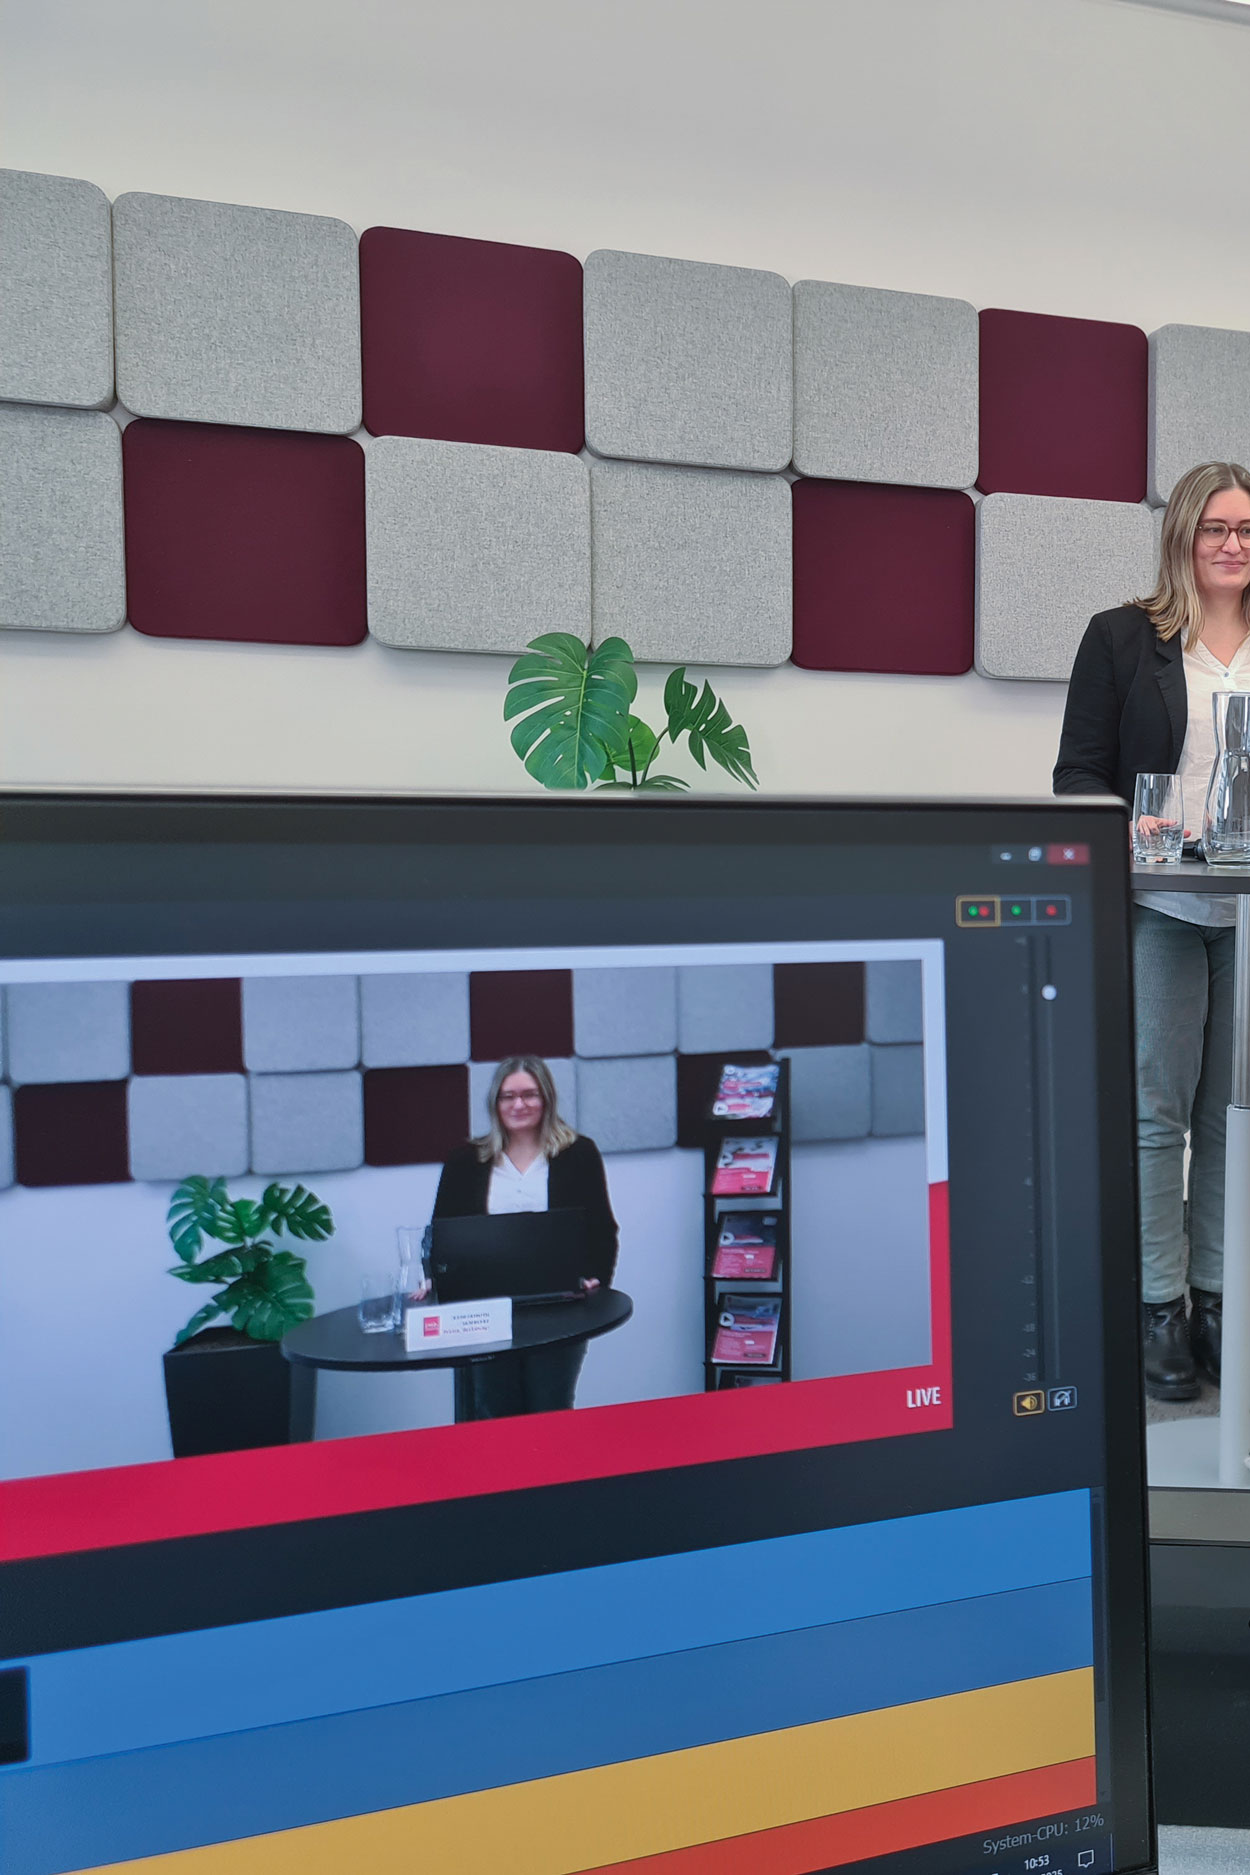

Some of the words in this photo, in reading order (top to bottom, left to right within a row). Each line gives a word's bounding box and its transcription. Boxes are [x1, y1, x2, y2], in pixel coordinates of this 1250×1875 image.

[907, 1387, 941, 1408] LIVE
[983, 1822, 1068, 1855] System-CPU:
[1074, 1813, 1105, 1832] 12%
[1024, 1854, 1050, 1870] 10:53
